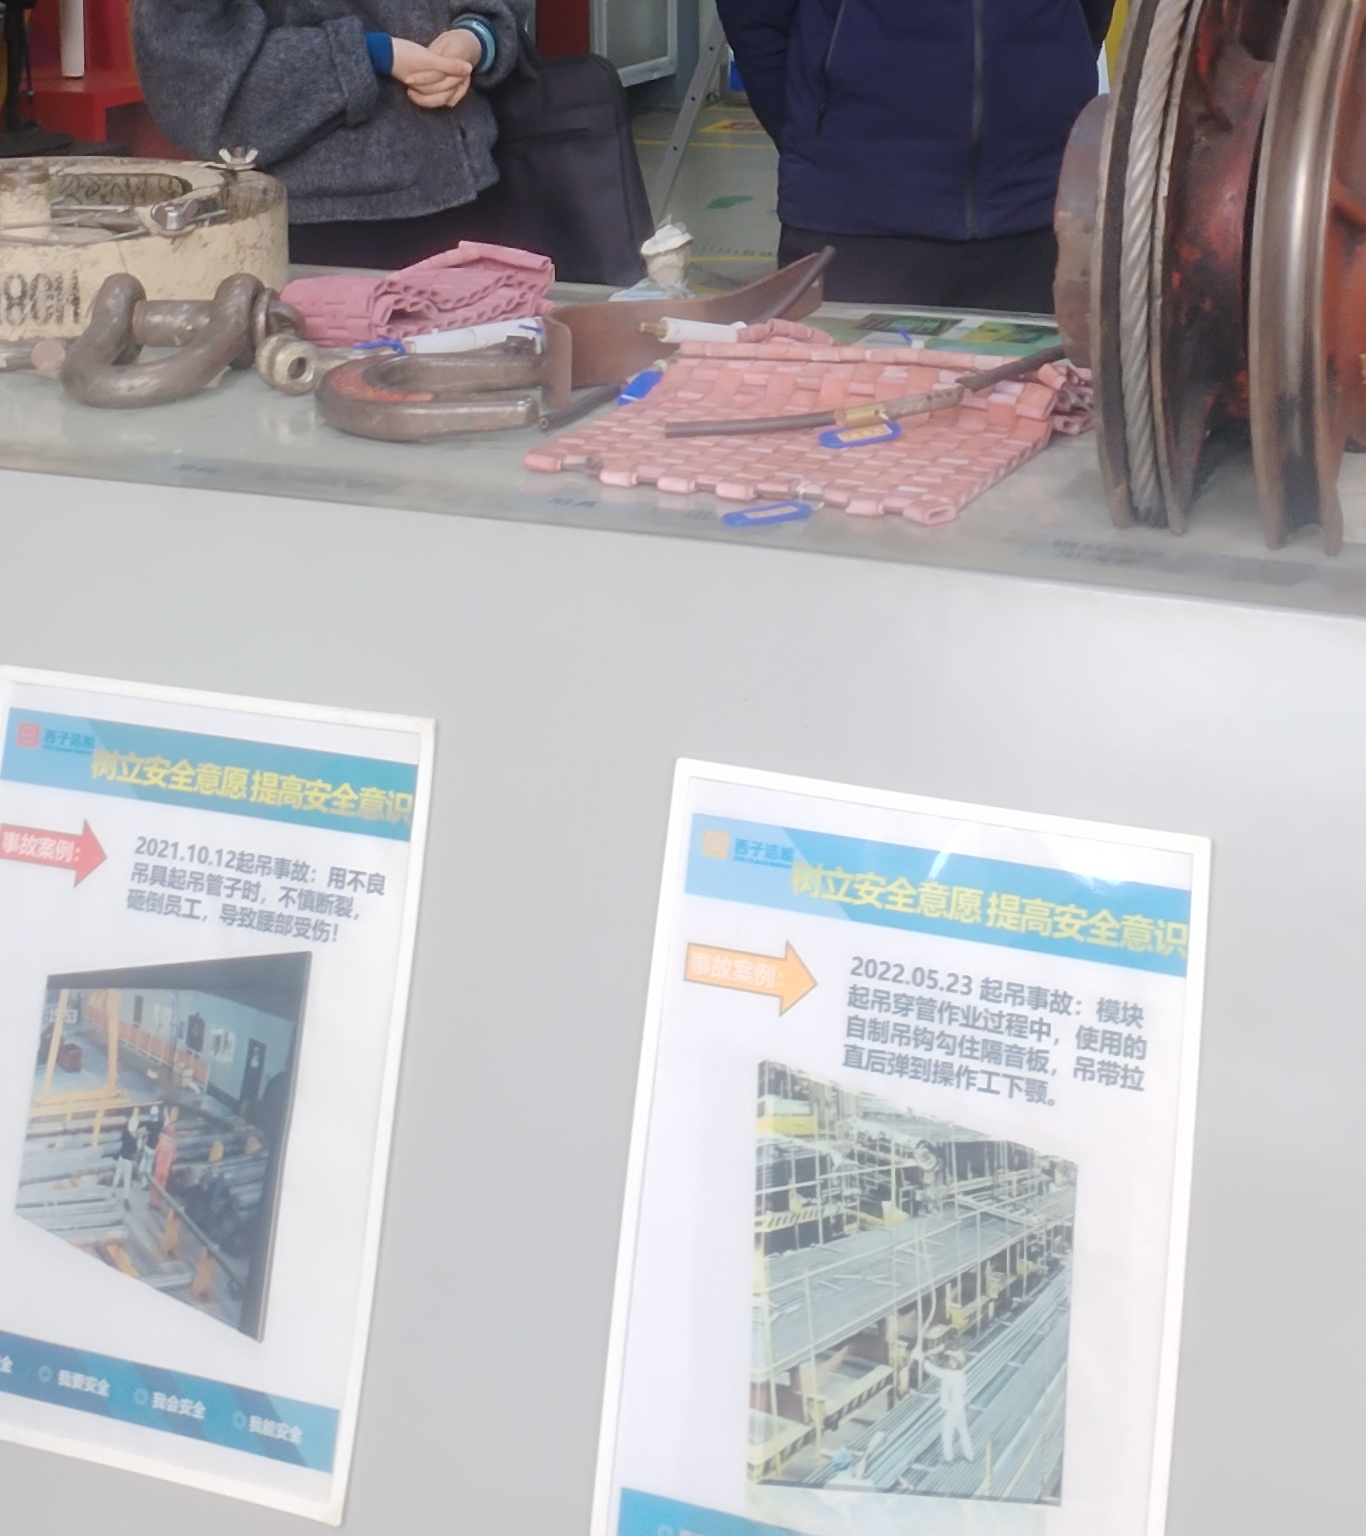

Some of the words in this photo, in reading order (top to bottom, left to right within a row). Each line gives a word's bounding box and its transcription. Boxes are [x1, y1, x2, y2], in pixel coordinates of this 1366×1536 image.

[90, 745, 250, 802] 树立安全意愿
[250, 770, 415, 827] 提高安全意识
[790, 858, 983, 926] 树立安全意愿
[986, 890, 1192, 962] 提高安全意识
[850, 955, 974, 997] 2022.05.23
